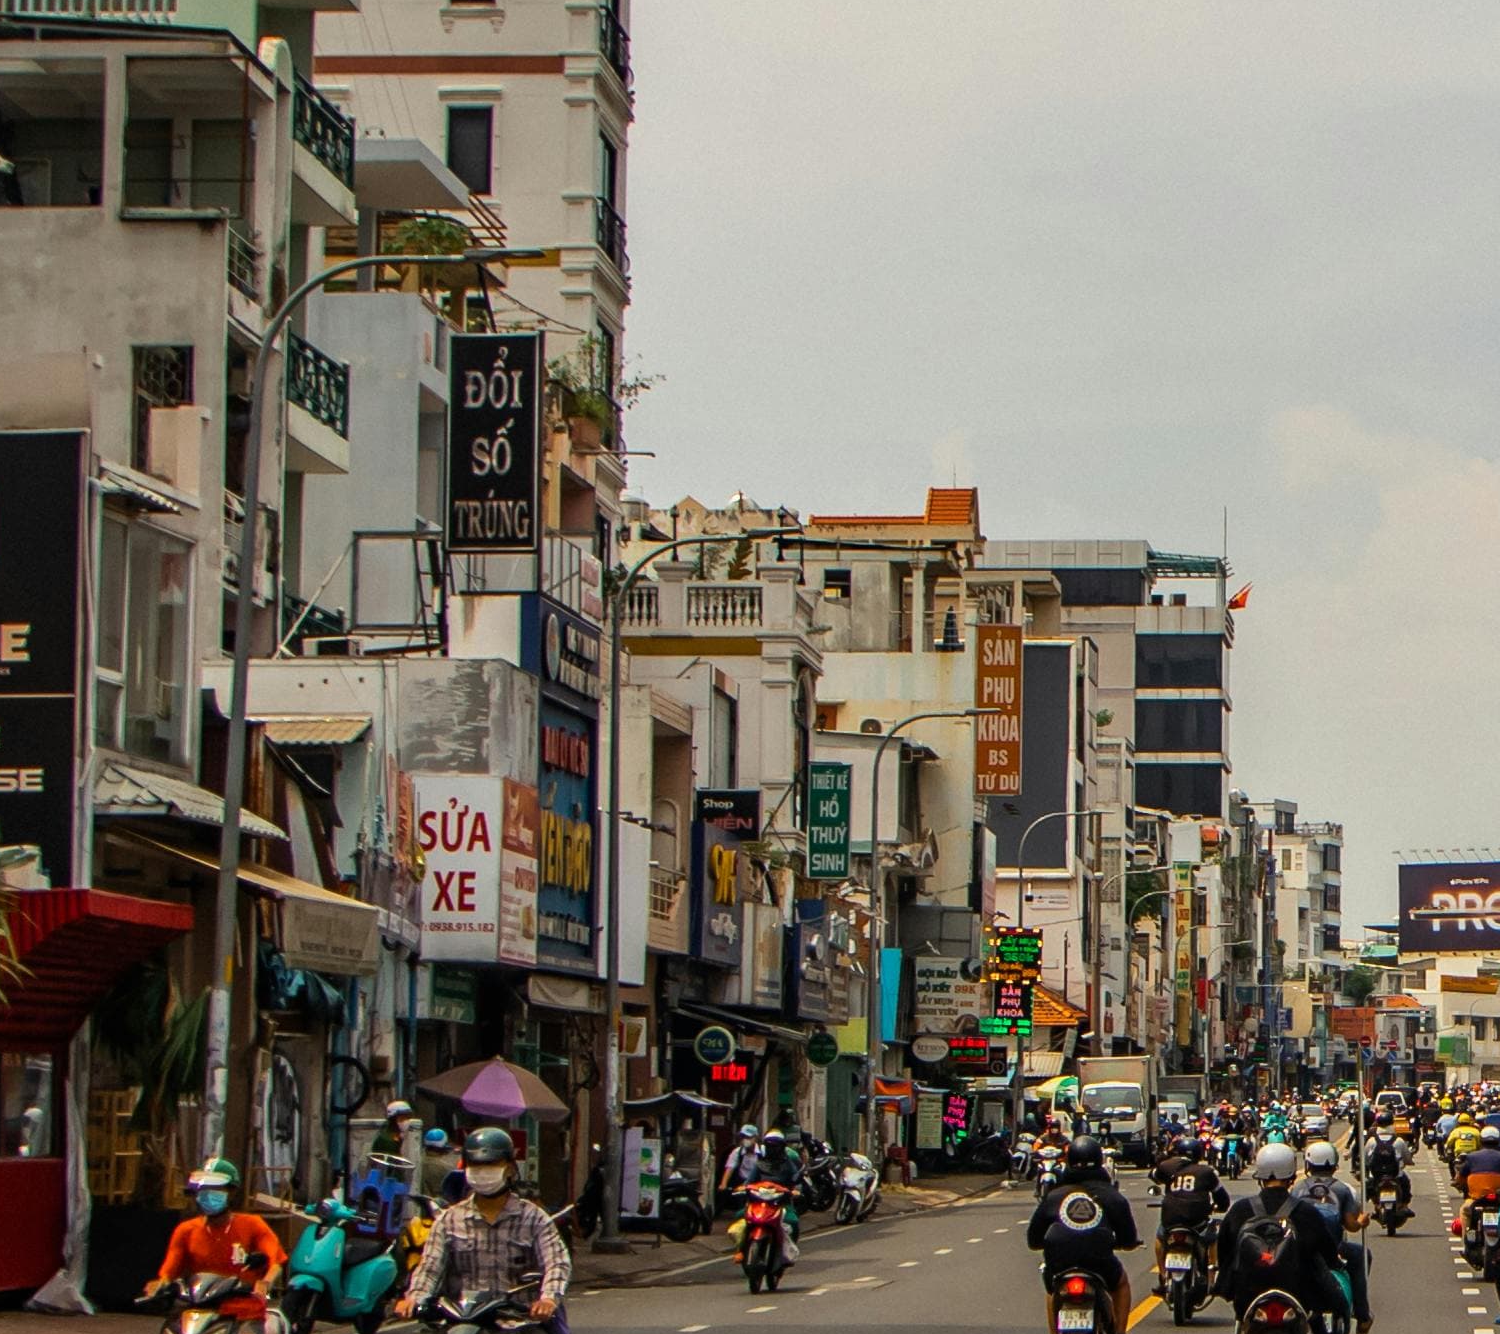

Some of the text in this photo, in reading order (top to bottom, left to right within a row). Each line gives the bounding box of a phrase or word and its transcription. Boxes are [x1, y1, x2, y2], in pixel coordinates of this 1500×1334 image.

[464, 346, 523, 409] ĐỔI
[471, 417, 515, 476] SỐ
[453, 489, 530, 539] TRÚNG
[983, 629, 1016, 666] SẢN
[983, 676, 1015, 710] PHỤ
[977, 715, 1020, 742] KHOA
[988, 749, 1008, 766] BS
[812, 770, 835, 790] THIẾT
[977, 770, 997, 790] TỪ
[702, 798, 734, 812] Shop
[418, 797, 492, 853] SỬA
[811, 853, 845, 872] SINH
[431, 870, 477, 912] XE
[1001, 984, 1022, 996] SẢN
[996, 1008, 1024, 1017] KHOA
